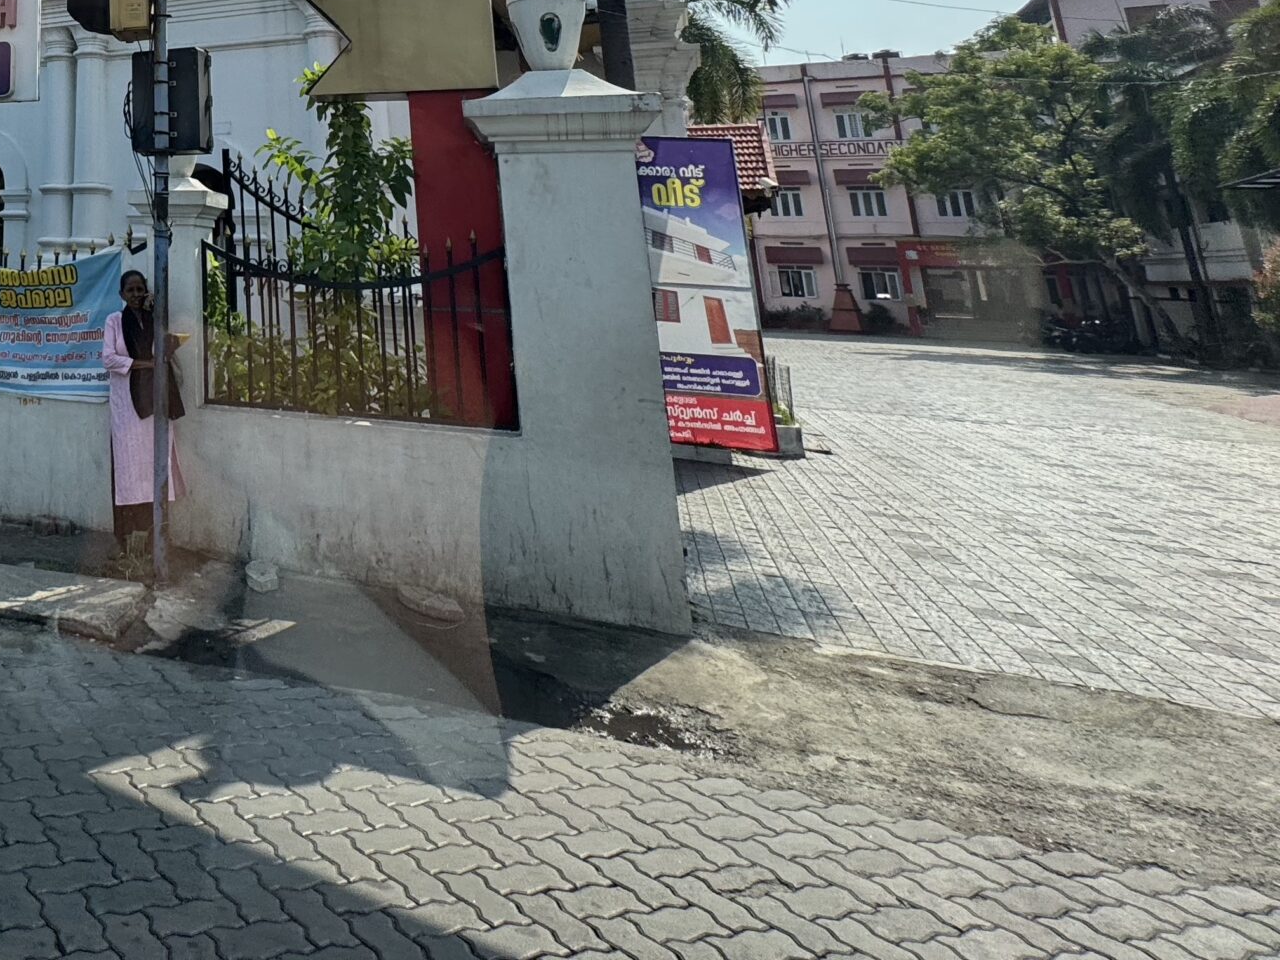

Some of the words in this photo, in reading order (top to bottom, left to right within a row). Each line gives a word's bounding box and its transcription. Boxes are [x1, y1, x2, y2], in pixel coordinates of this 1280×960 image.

[771, 144, 815, 157] HIGHER
[679, 164, 705, 177] വീട്
[652, 178, 705, 207] വീട്
[0, 287, 73, 308] ജപമാല
